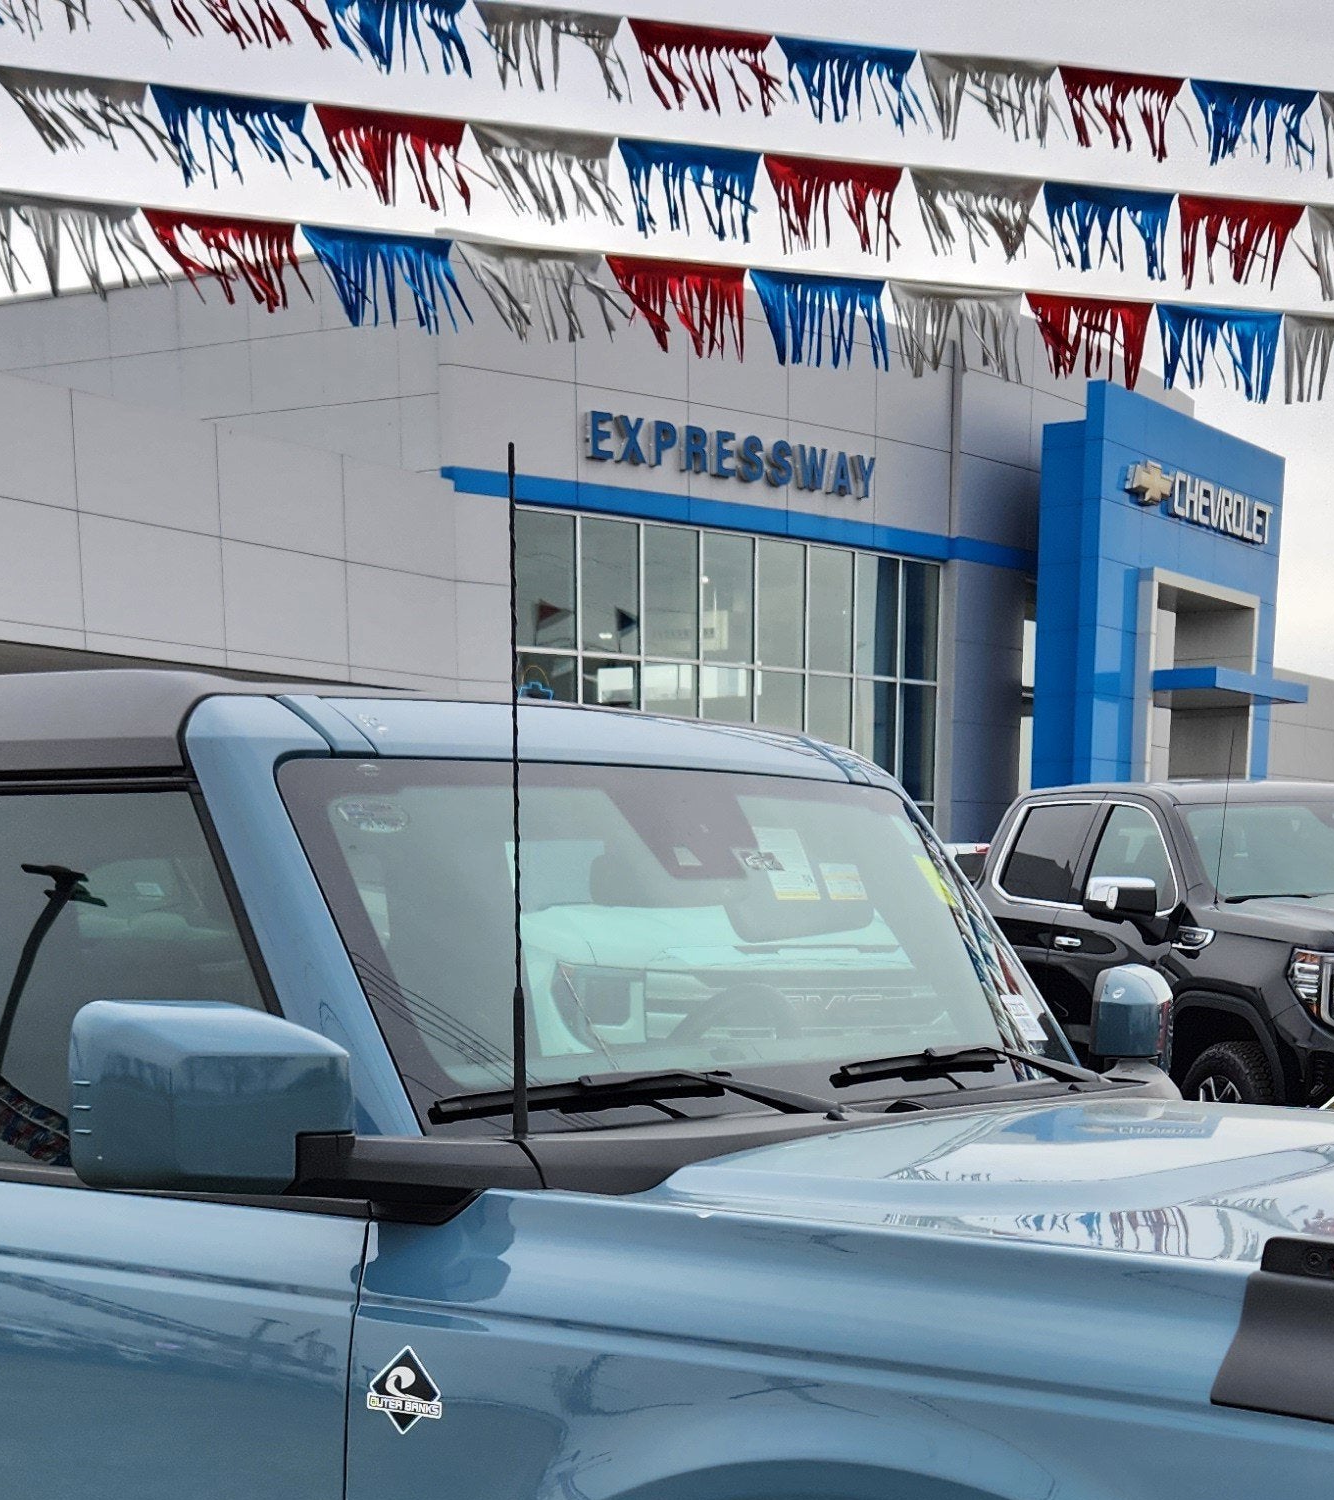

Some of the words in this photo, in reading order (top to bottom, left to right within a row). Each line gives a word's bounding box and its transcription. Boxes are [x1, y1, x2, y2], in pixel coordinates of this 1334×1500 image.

[586, 411, 875, 500] EXPRESSWAY
[1173, 471, 1273, 544] CHEVROLET
[369, 1396, 403, 1410] OUTER
[404, 1401, 439, 1415] BANKS
